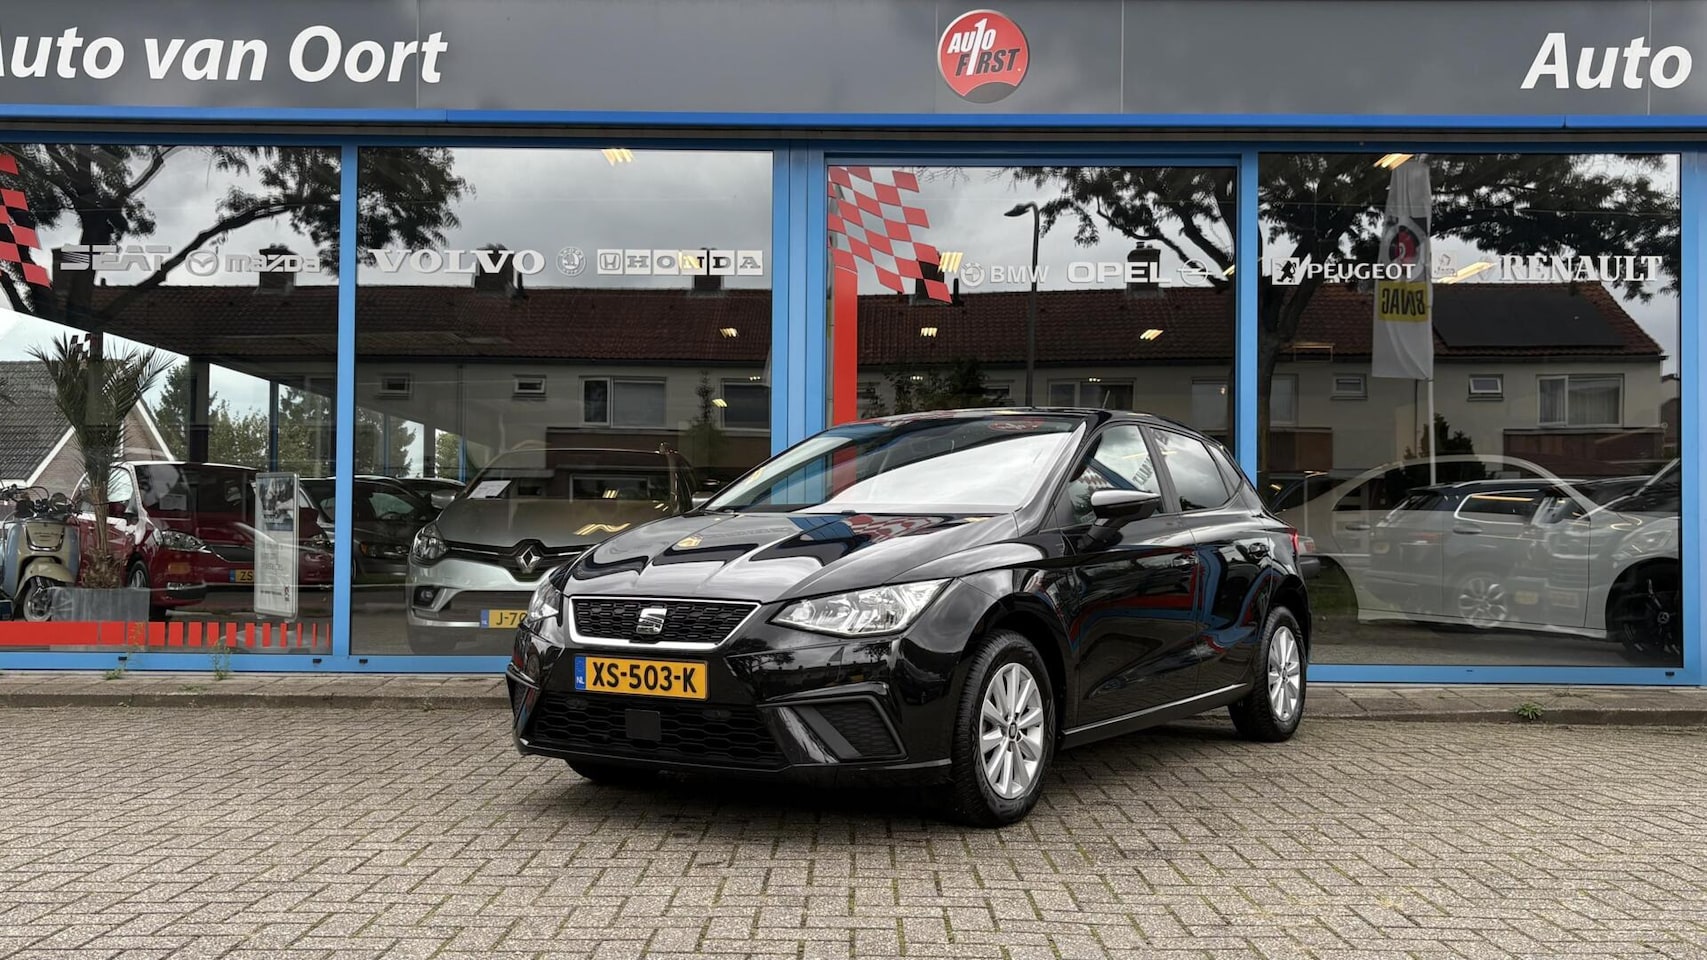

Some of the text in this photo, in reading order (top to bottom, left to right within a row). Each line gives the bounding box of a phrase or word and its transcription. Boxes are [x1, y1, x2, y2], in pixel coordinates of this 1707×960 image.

[0, 25, 448, 83] uto van Oort
[1520, 32, 1692, 89] Auto
[60, 245, 171, 271] SEAT
[368, 249, 546, 274] VOLVO
[626, 253, 762, 271] HONDA
[1500, 254, 1663, 282] RENAULT
[990, 265, 1049, 284] BMW
[1067, 262, 1172, 283] OPEL
[1307, 262, 1417, 280] PEUGEOT
[592, 662, 697, 693] XS-503-K
